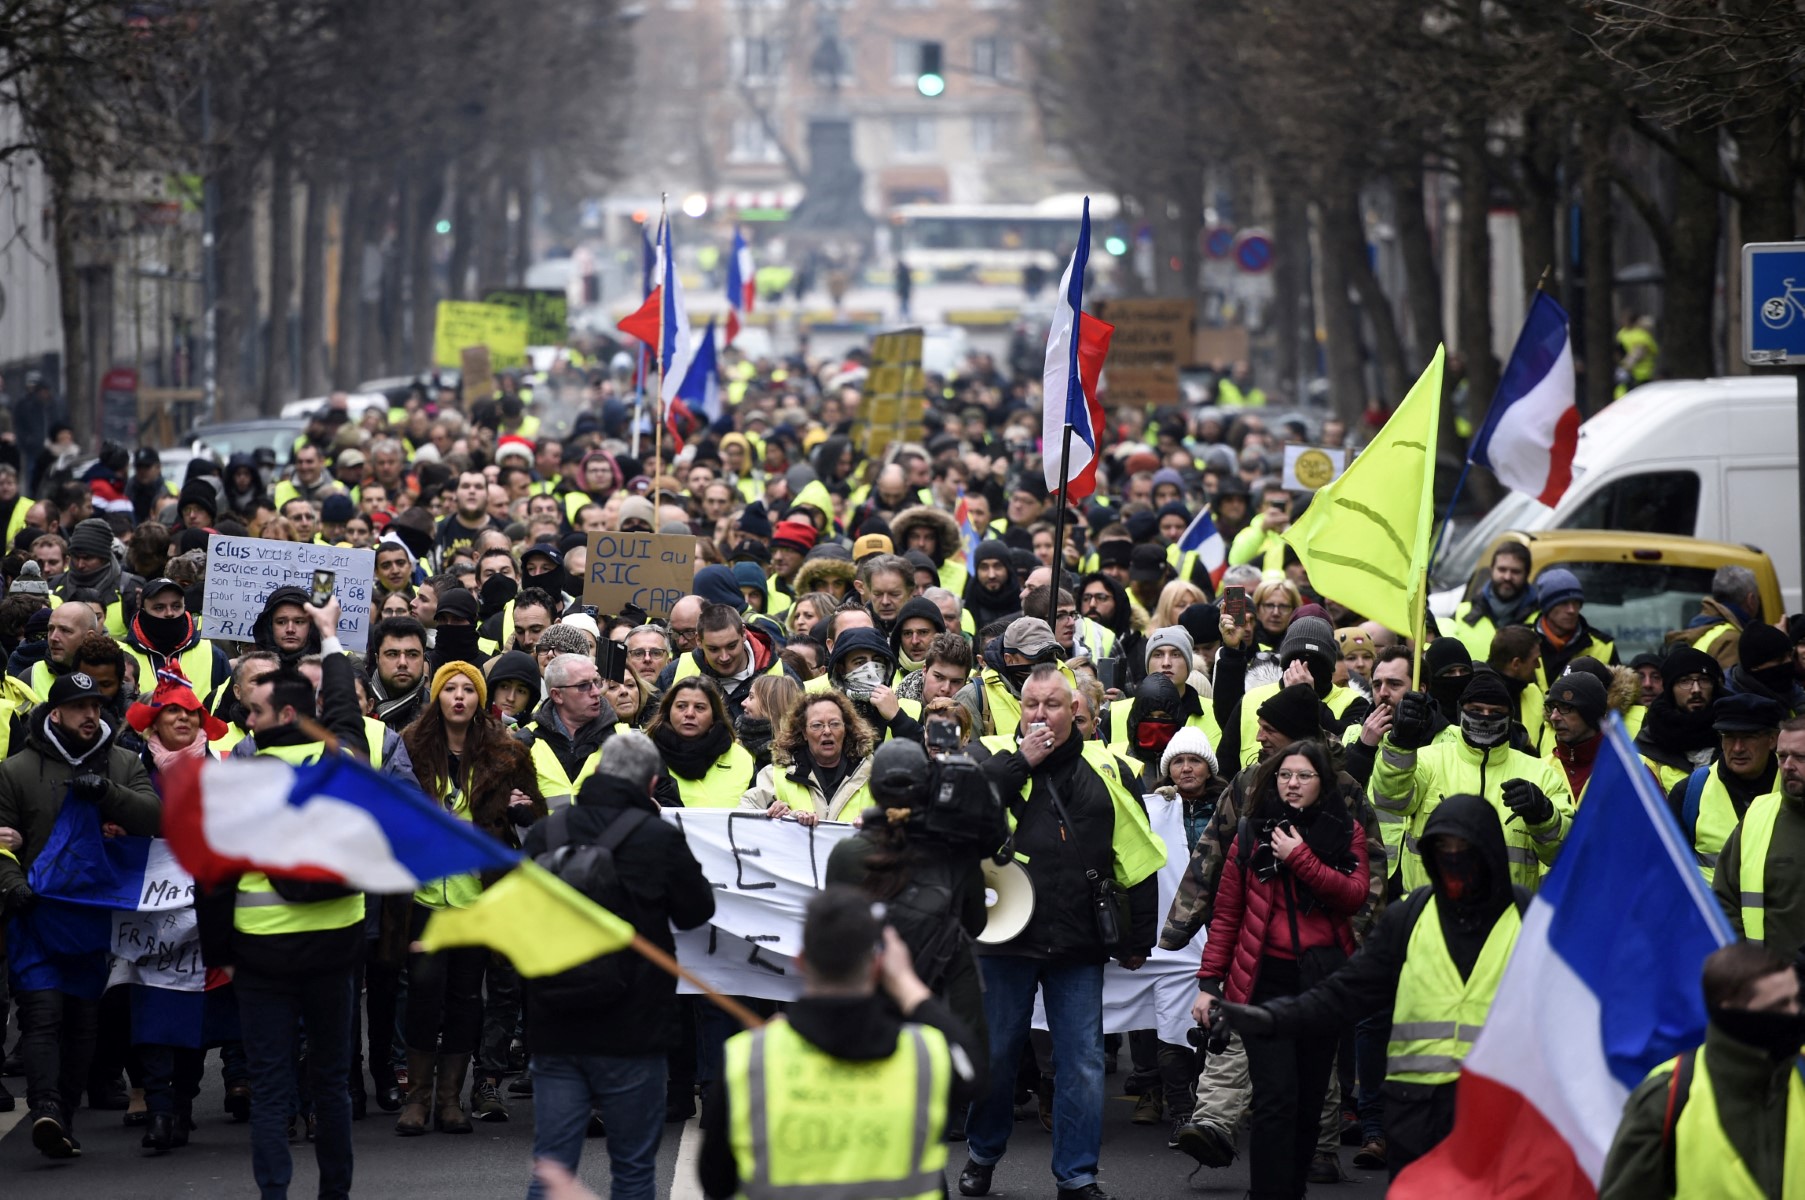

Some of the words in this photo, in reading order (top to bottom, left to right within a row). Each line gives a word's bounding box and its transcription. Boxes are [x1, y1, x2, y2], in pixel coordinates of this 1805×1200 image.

[215, 541, 251, 560] Elus
[256, 547, 292, 562] vous
[331, 555, 351, 567] au
[596, 536, 652, 559] OUI
[660, 551, 687, 565] au
[213, 562, 259, 576] service
[261, 565, 279, 577] du
[343, 576, 370, 589] pour
[591, 562, 640, 586] RIC
[209, 591, 235, 607] pour
[242, 591, 251, 602] la
[211, 577, 229, 588] son
[348, 586, 366, 601] 68
[632, 588, 685, 613] CAR
[209, 606, 238, 619] nous
[142, 879, 196, 907] MAR
